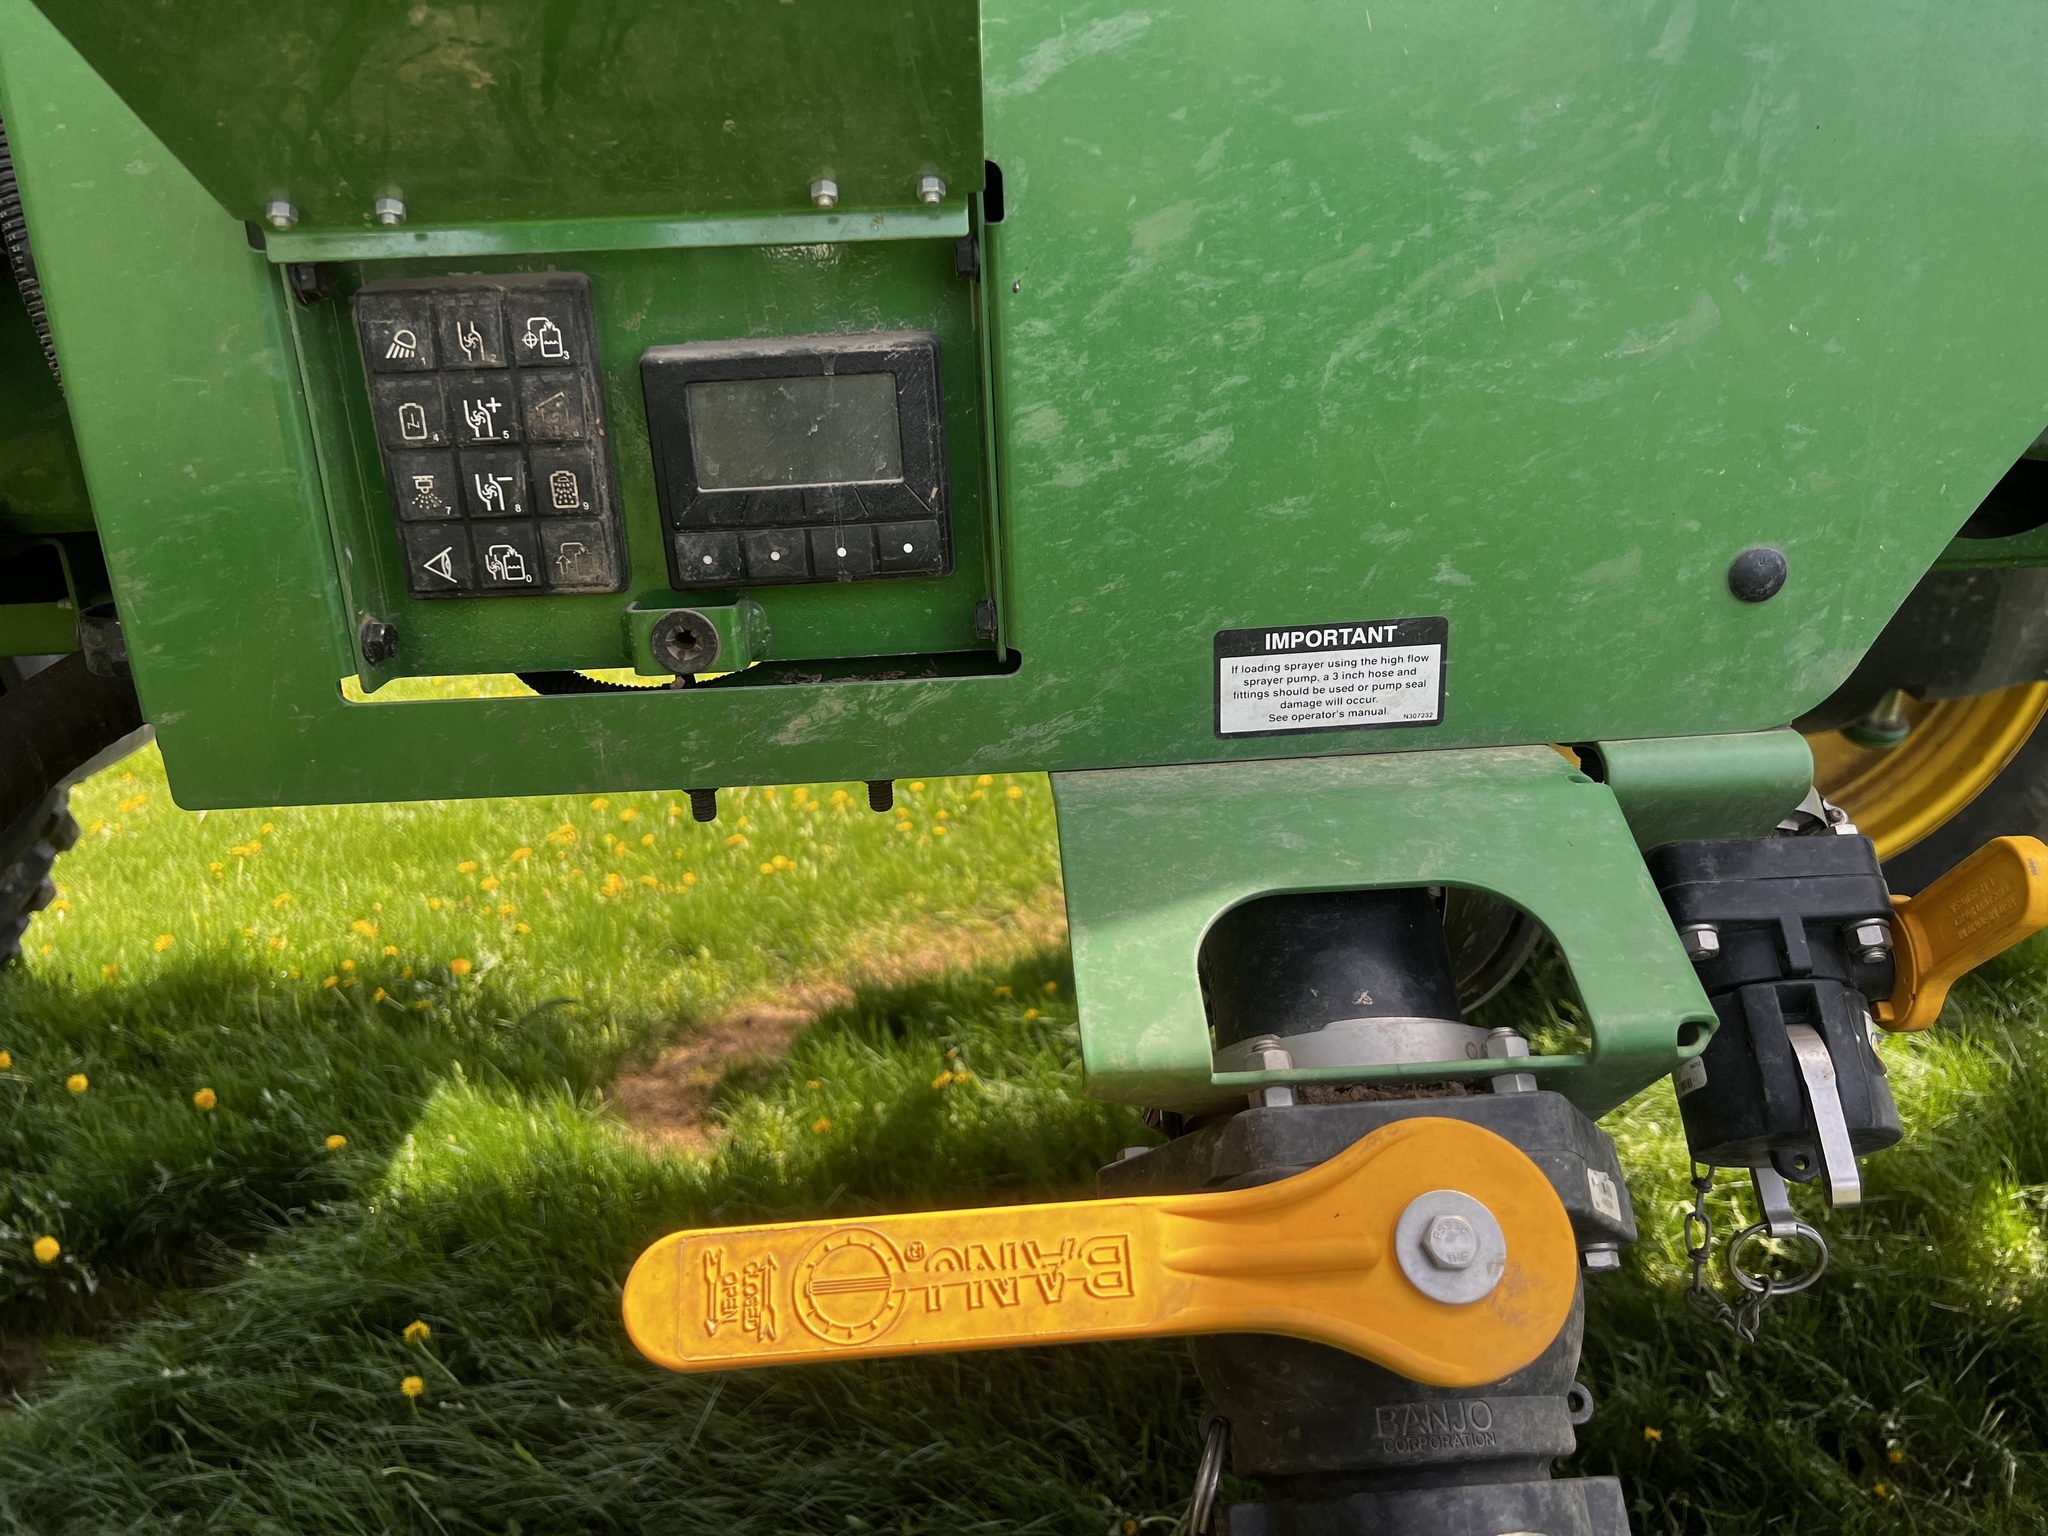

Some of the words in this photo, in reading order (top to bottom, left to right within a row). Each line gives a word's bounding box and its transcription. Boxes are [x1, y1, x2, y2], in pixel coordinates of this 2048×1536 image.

[491, 354, 497, 363] 2
[563, 351, 570, 360] 3
[432, 433, 440, 442] 4
[503, 430, 510, 439] 5
[445, 506, 452, 515] 7
[514, 504, 522, 513] 8
[583, 501, 590, 510] 9
[1265, 625, 1398, 650] IMPORTANT
[1231, 665, 1239, 674] If
[1241, 662, 1281, 674] loading
[1284, 660, 1324, 673] sprayer
[1327, 658, 1357, 670] using
[1360, 656, 1378, 666] the
[1380, 655, 1404, 666] high
[1407, 654, 1430, 663] flow
[1243, 676, 1283, 688] sprayer
[1286, 674, 1320, 685] pump,
[1323, 673, 1329, 681] a
[1332, 671, 1339, 680] 3
[1341, 669, 1365, 680] inch
[1368, 668, 1394, 679] hose
[1397, 667, 1417, 677] and
[1233, 688, 1270, 700] fittings
[1273, 686, 1309, 697] should
[1312, 685, 1326, 695] be
[1329, 683, 1354, 693] used
[1357, 683, 1369, 691] or
[1371, 681, 1402, 693] pump
[1405, 679, 1427, 689] seal
[1280, 699, 1322, 710] damage
[1325, 697, 1343, 706] will
[1346, 696, 1379, 705] occur.
[1268, 713, 1289, 723] See
[1291, 709, 1345, 722] operator's
[1348, 707, 1390, 717] manual.
[1403, 712, 1433, 720] N307232
[1446, 1250, 1469, 1263] THE
[720, 1272, 738, 1324] OPEN
[1375, 1399, 1494, 1437] BANJO
[1383, 1431, 1497, 1453] CORPORATION
